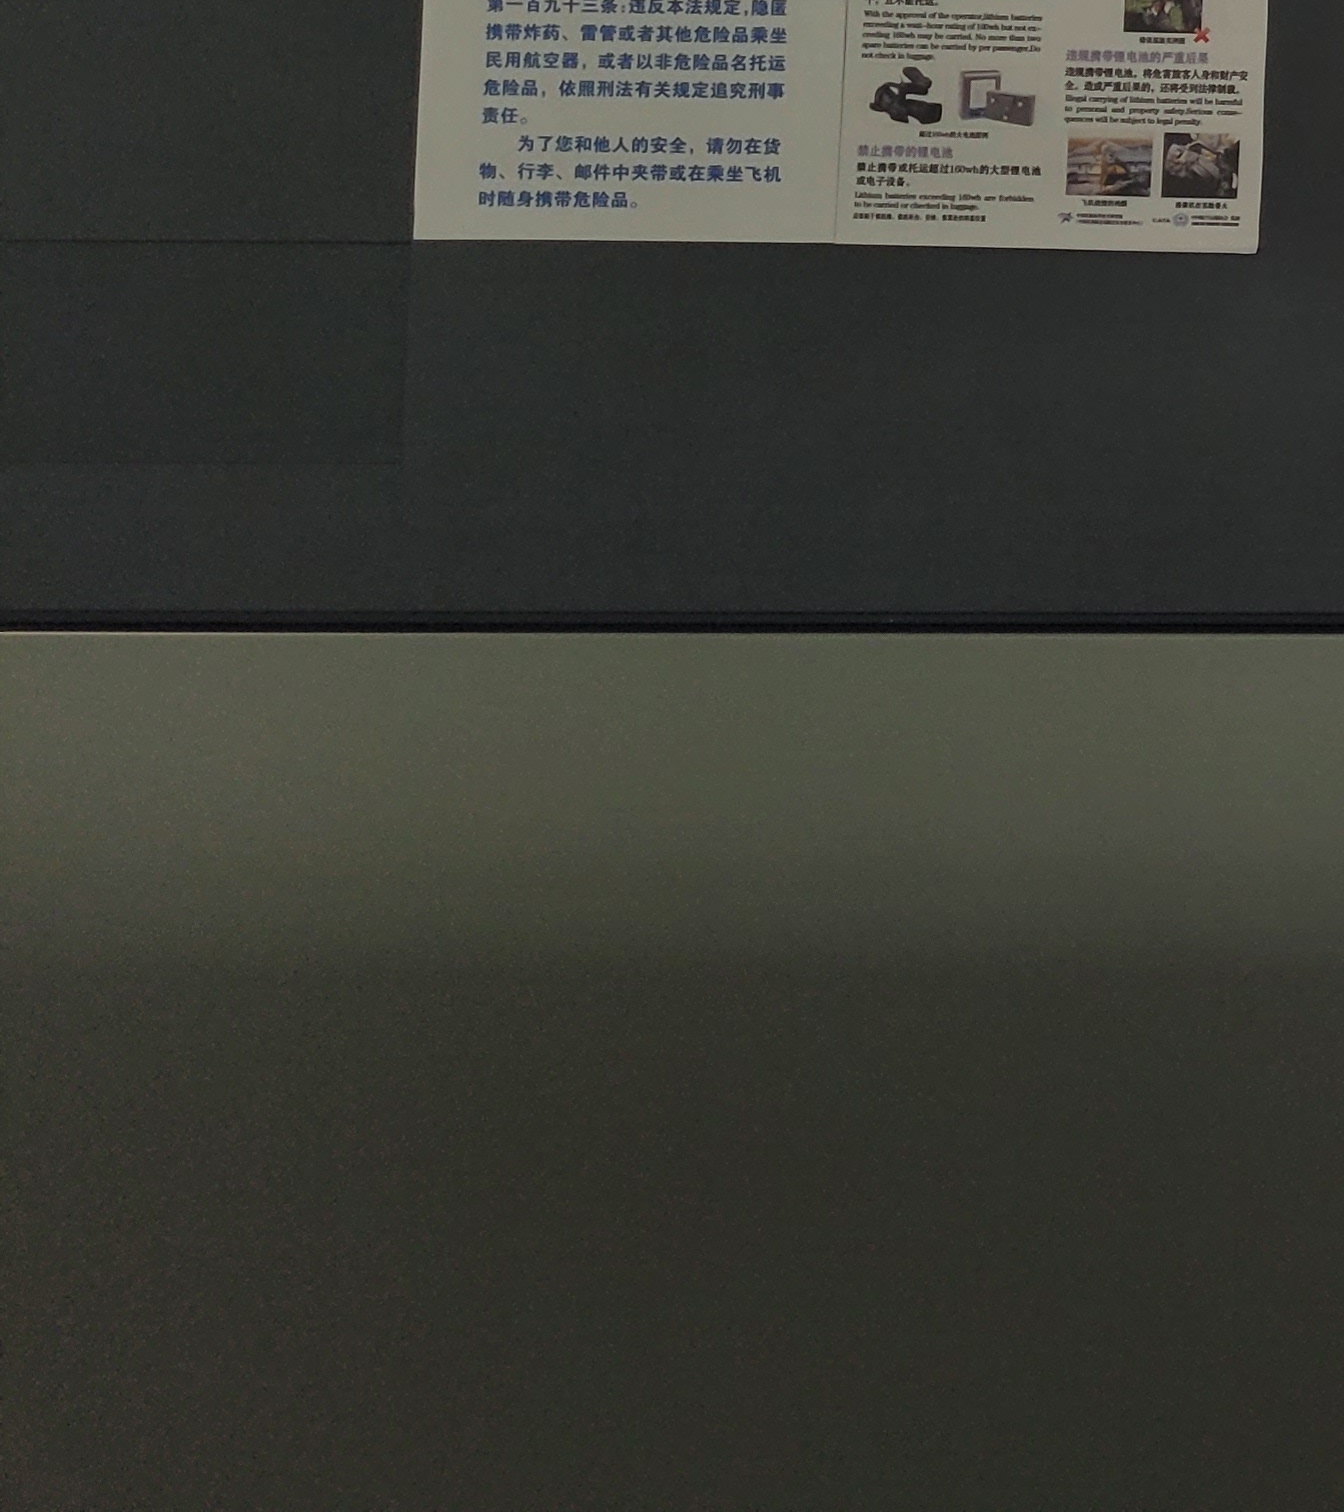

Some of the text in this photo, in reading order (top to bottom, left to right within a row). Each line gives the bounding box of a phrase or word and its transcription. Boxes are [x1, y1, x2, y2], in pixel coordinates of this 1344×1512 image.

[485, 24, 787, 44] 携带炸药、雷管或者其他危险品乘坐
[482, 107, 528, 125] 责任。
[478, 163, 782, 183] 物、行李、邮件中夹带或在乘坐飞机
[478, 190, 638, 209] 时随身携带危险品。
